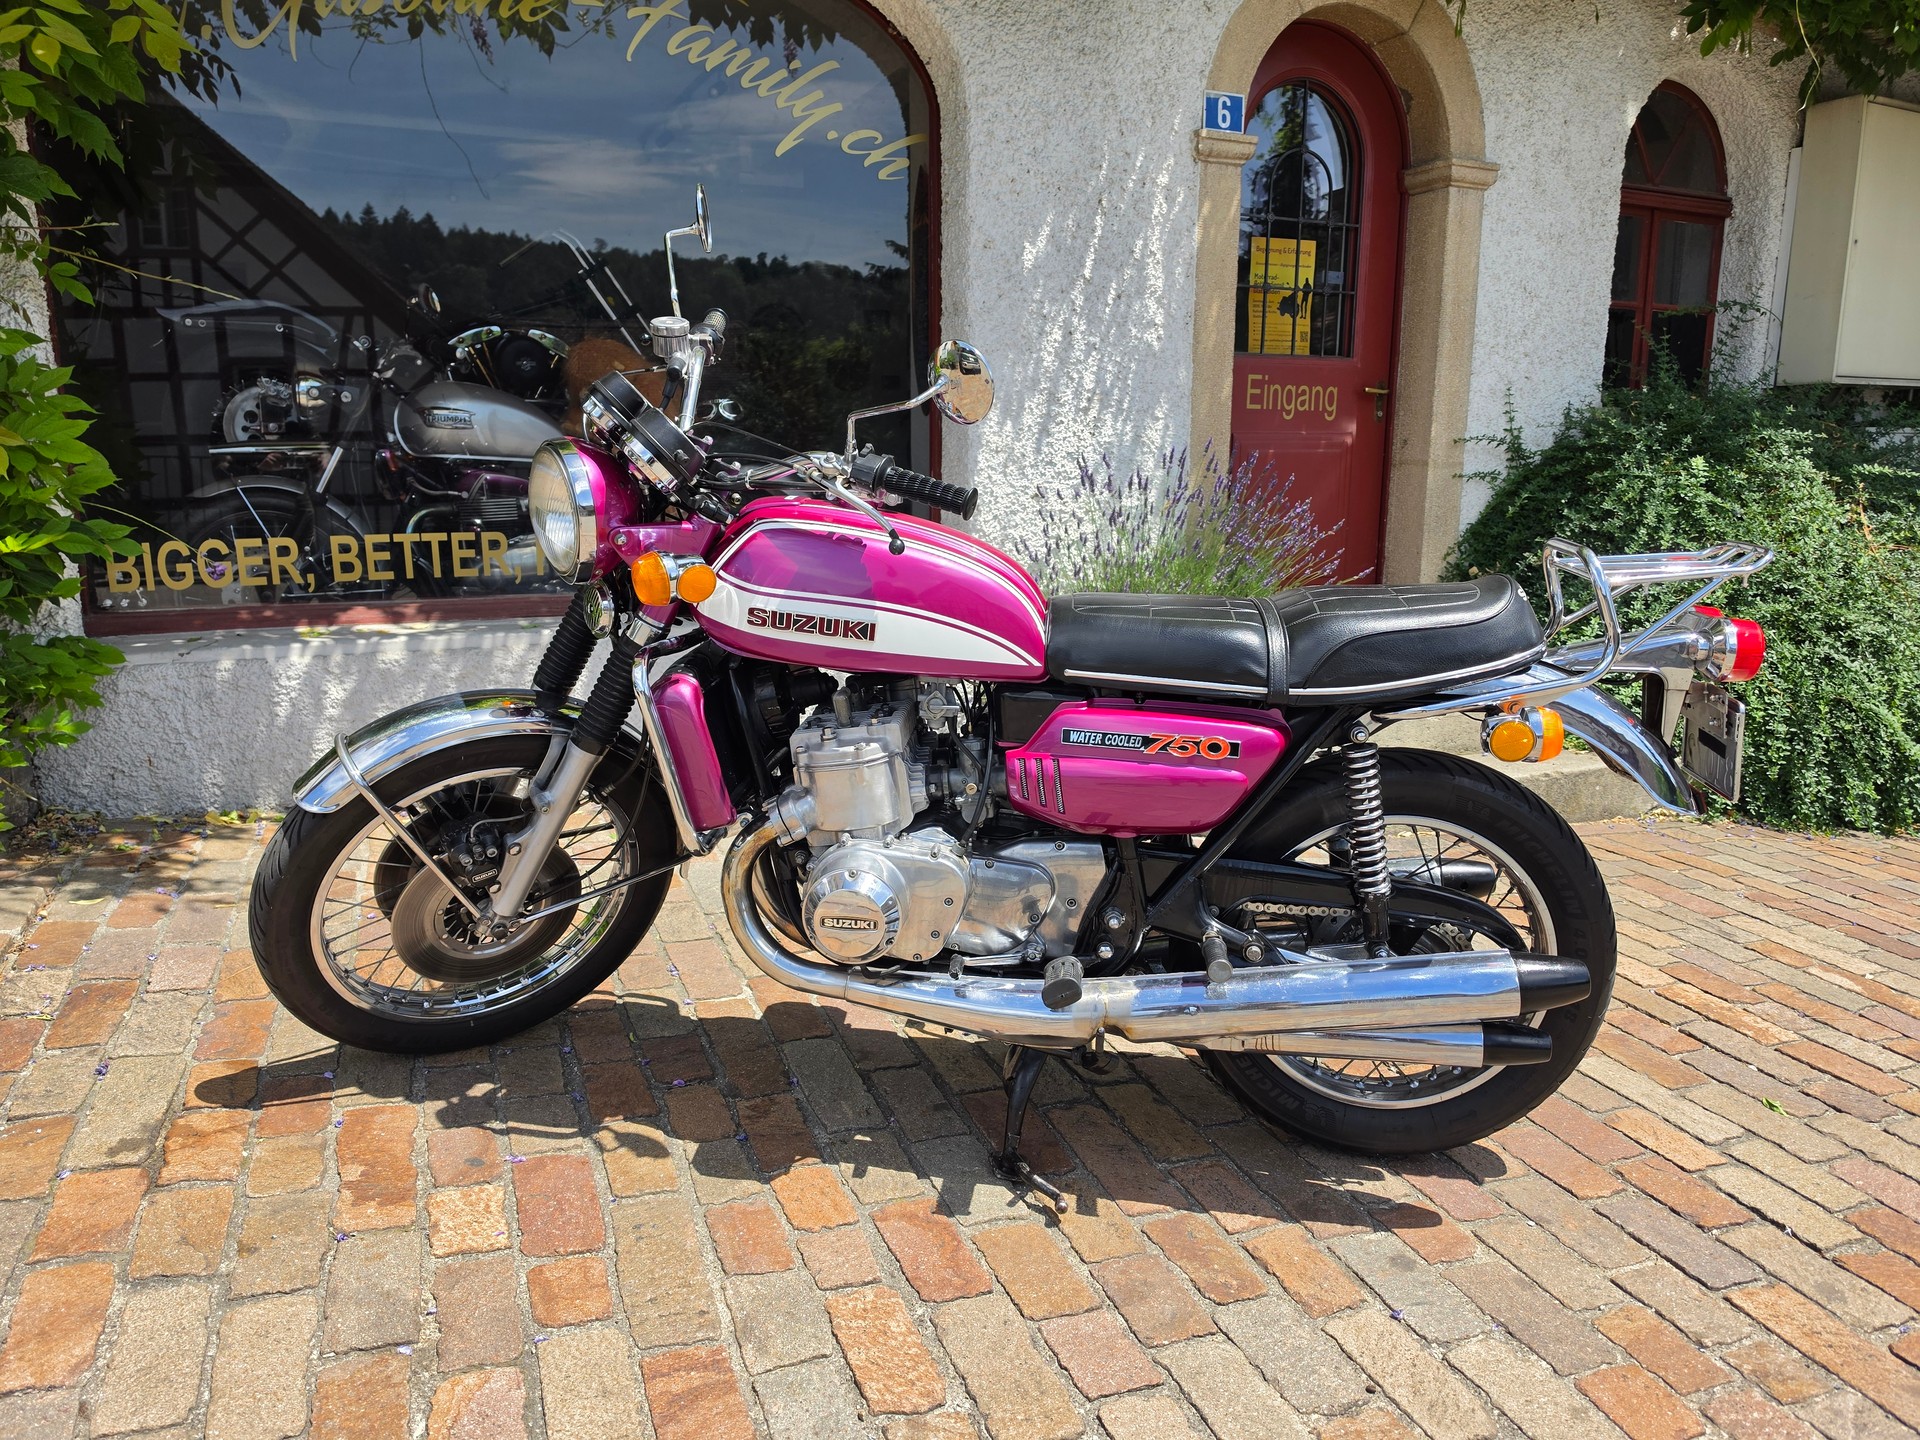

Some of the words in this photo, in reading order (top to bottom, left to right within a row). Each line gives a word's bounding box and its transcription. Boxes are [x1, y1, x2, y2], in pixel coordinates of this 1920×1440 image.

[1217, 95, 1232, 129] 6
[1246, 374, 1338, 421] Eingang
[105, 537, 315, 593] BIGGER,
[330, 531, 522, 585] BETTER,
[746, 607, 877, 641] SUZUKI
[1070, 730, 1102, 745] WATER
[1105, 734, 1143, 748] COOLED
[1143, 733, 1231, 760] 750
[823, 918, 875, 929] SUZUKI
